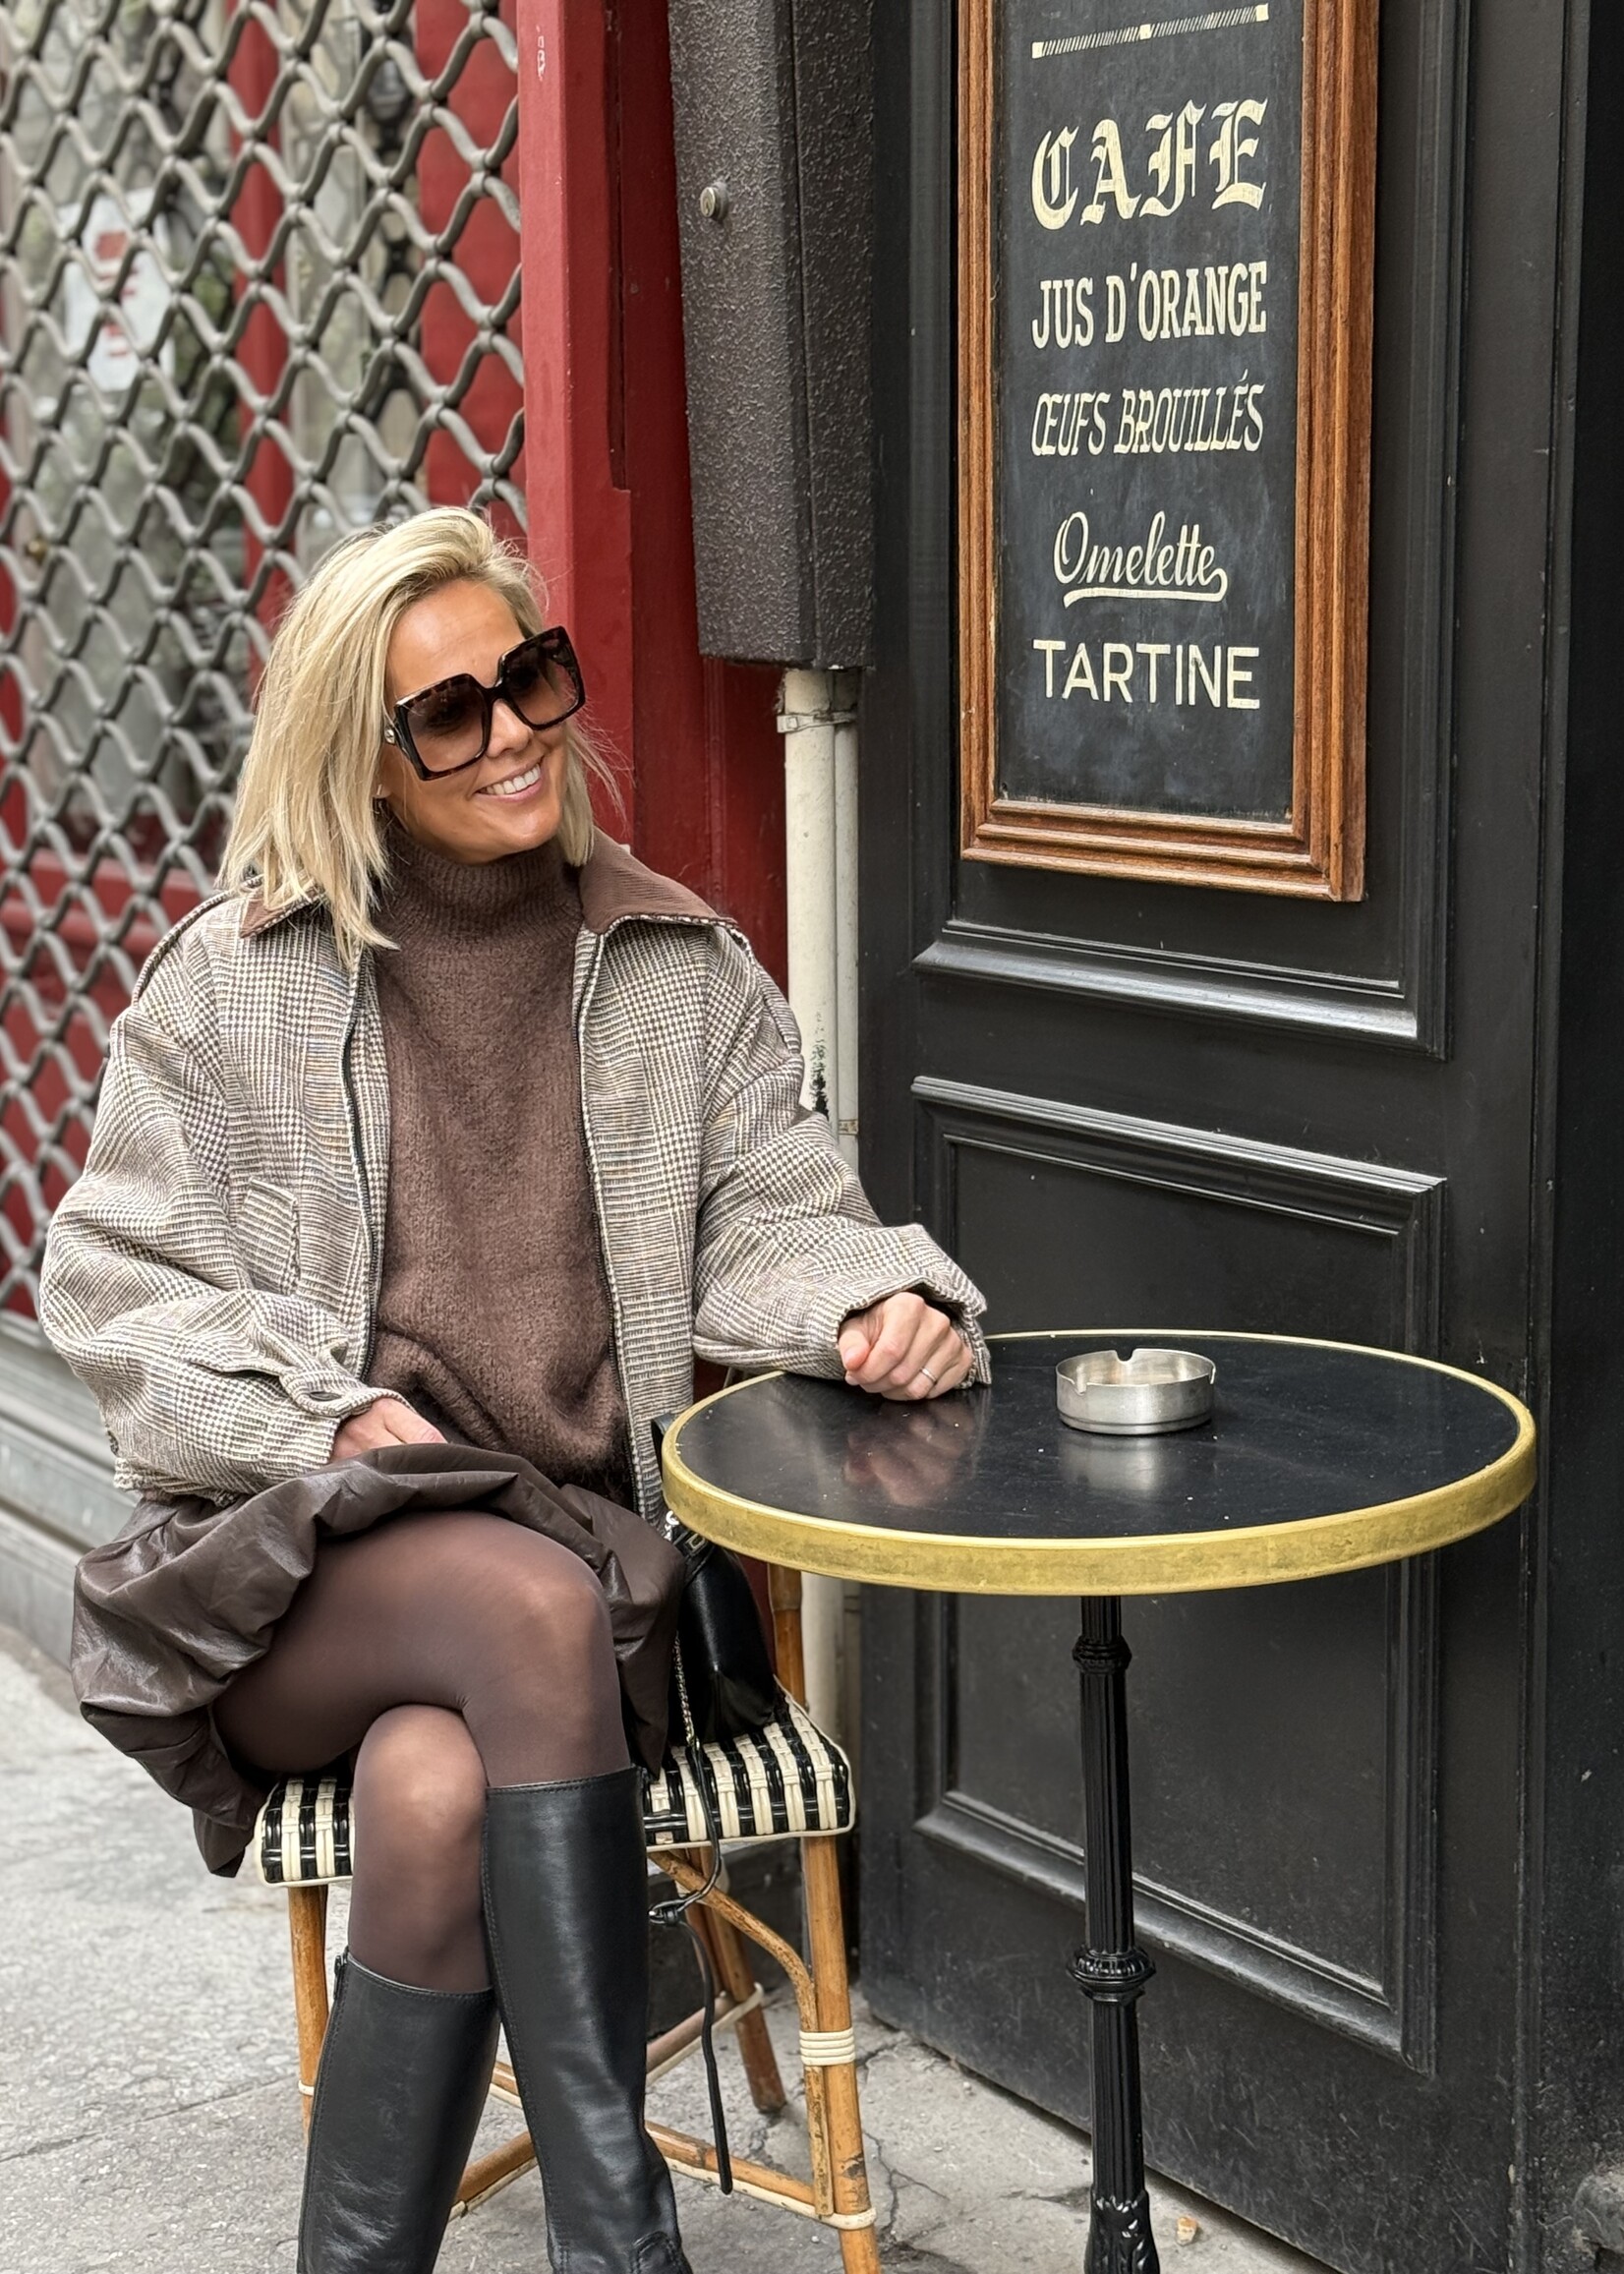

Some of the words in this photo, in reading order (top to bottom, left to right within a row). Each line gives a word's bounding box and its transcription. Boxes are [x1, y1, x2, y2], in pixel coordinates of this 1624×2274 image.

[1031, 98, 1268, 230] CAFE
[1031, 277, 1094, 349] JUS
[1105, 261, 1267, 343] D'ORANGE
[1031, 391, 1111, 456] ŒUFS
[1113, 369, 1265, 454] BROUILLÉS
[1053, 510, 1228, 609] Omelette
[1032, 639, 1260, 710] TARTINE
